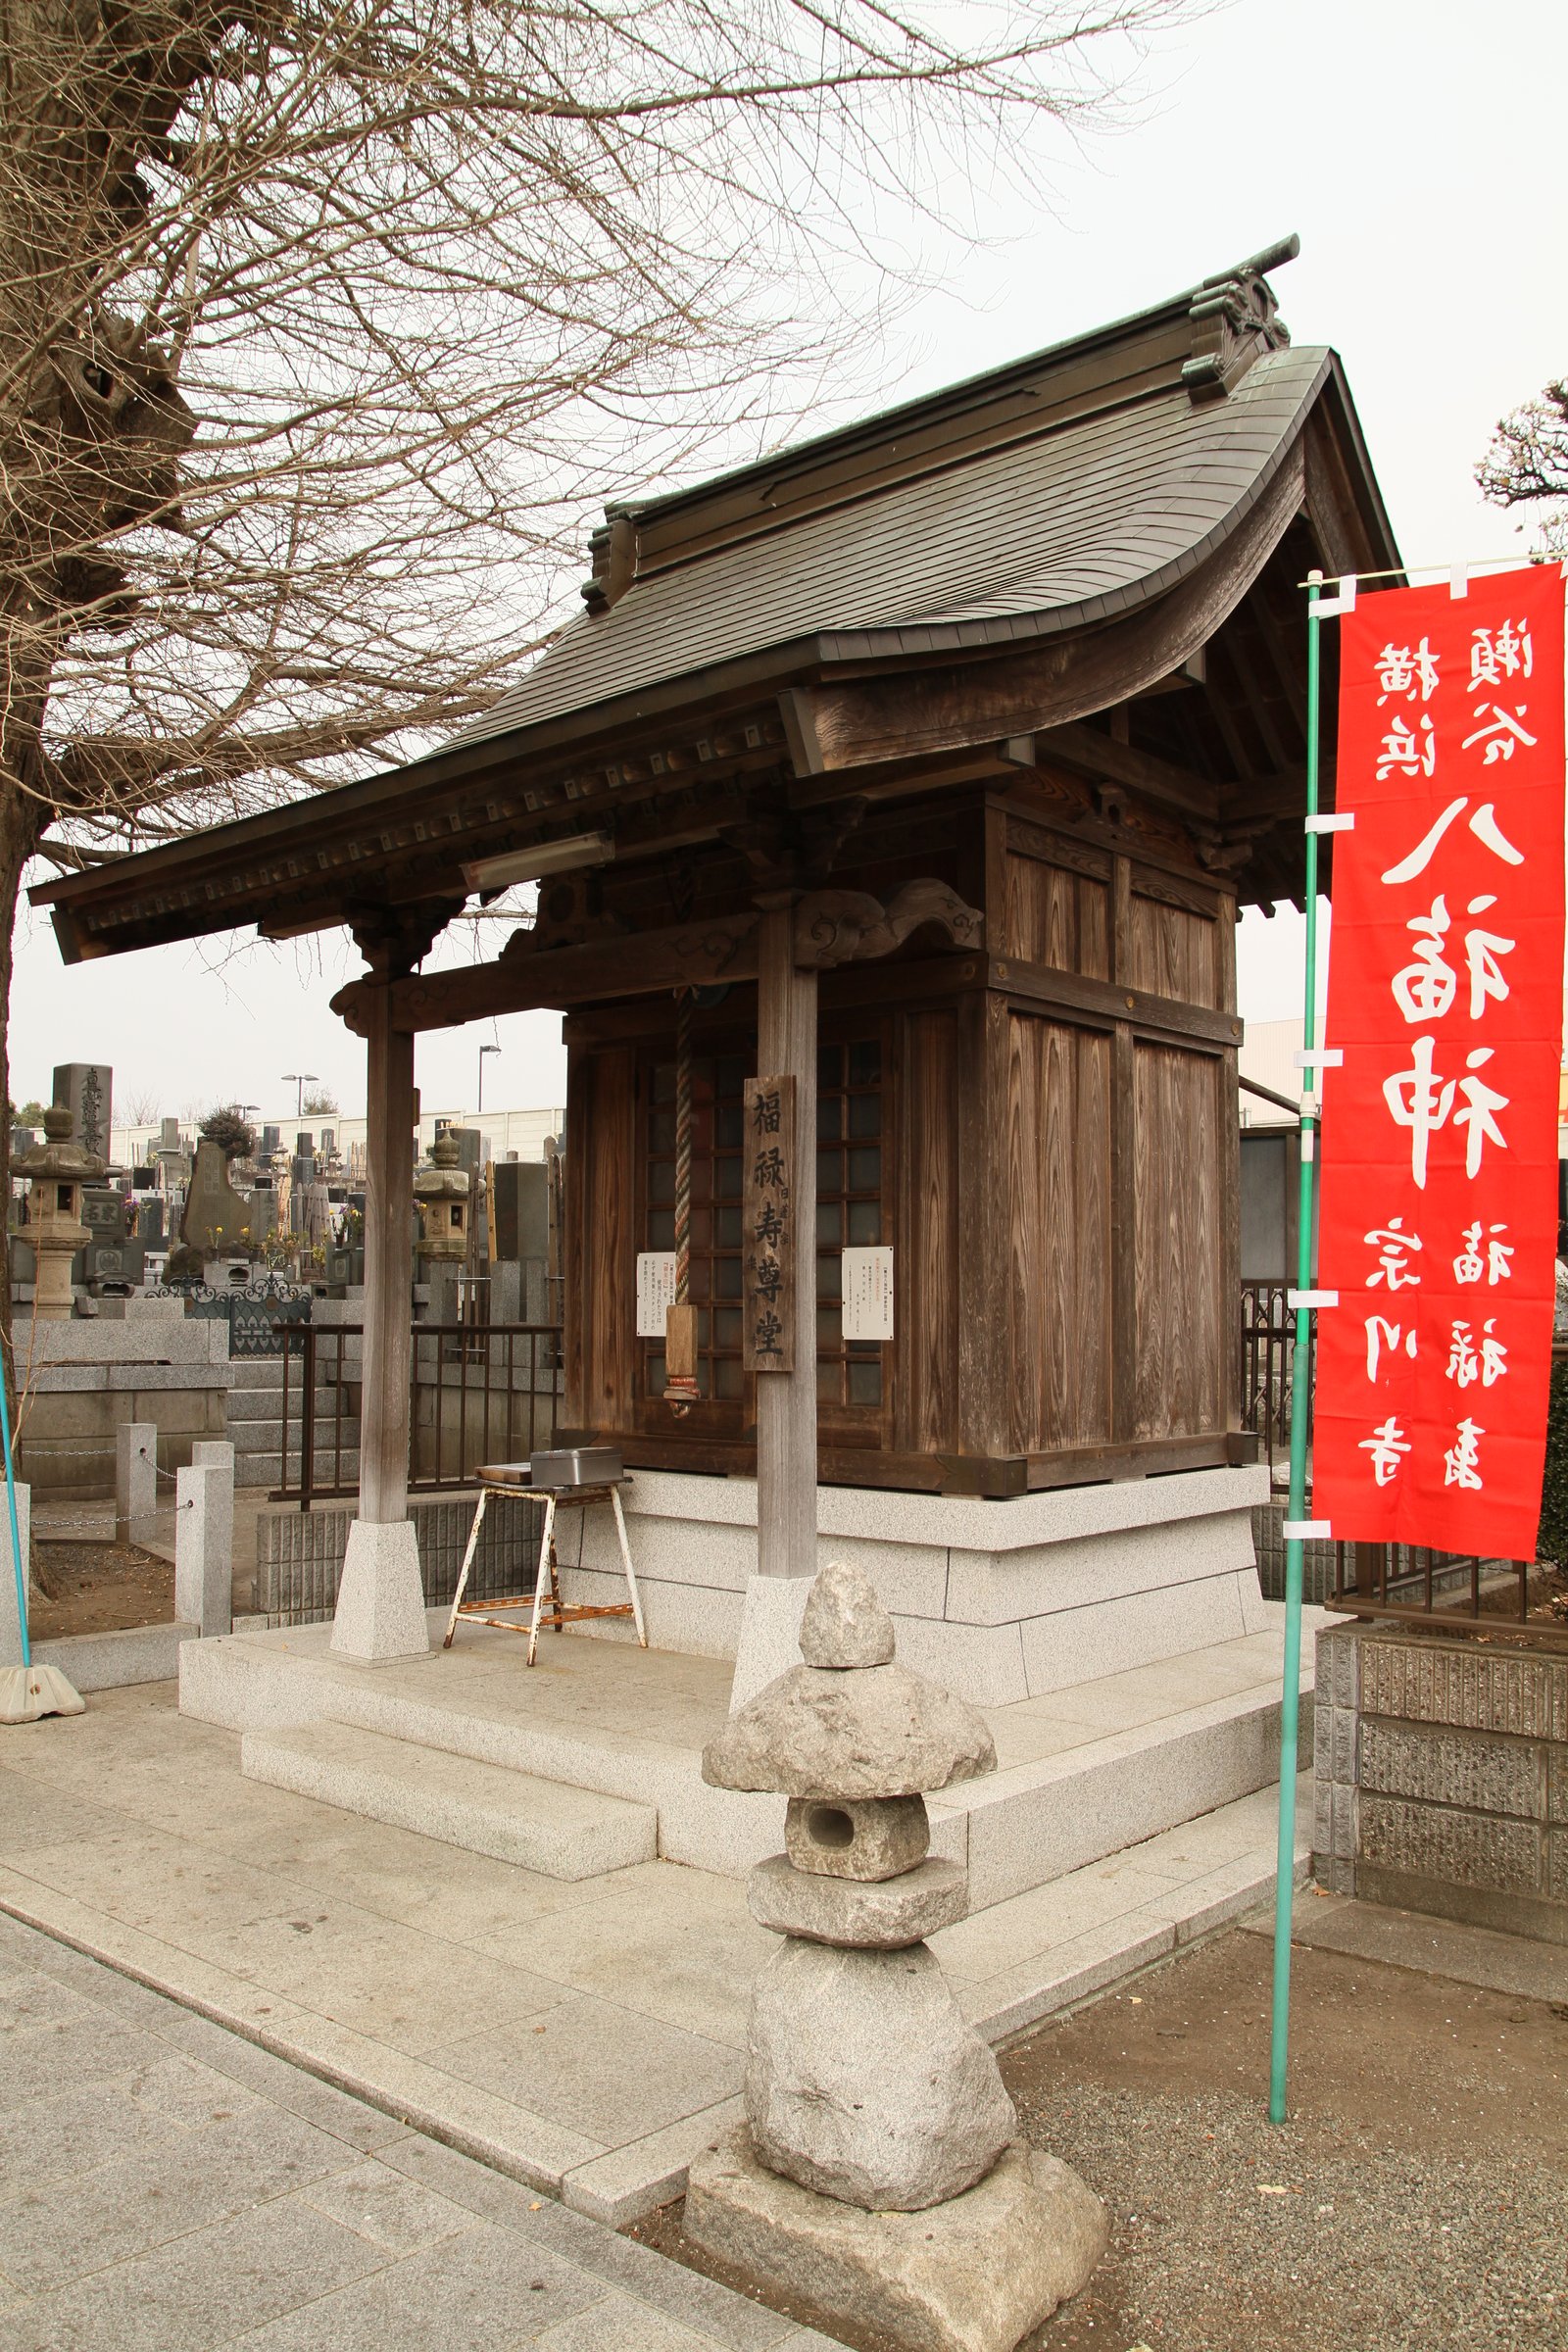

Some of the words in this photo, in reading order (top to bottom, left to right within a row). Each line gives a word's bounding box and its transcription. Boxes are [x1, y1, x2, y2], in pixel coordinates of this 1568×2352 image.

[753, 1091, 784, 1356] 福禄寿尊堂
